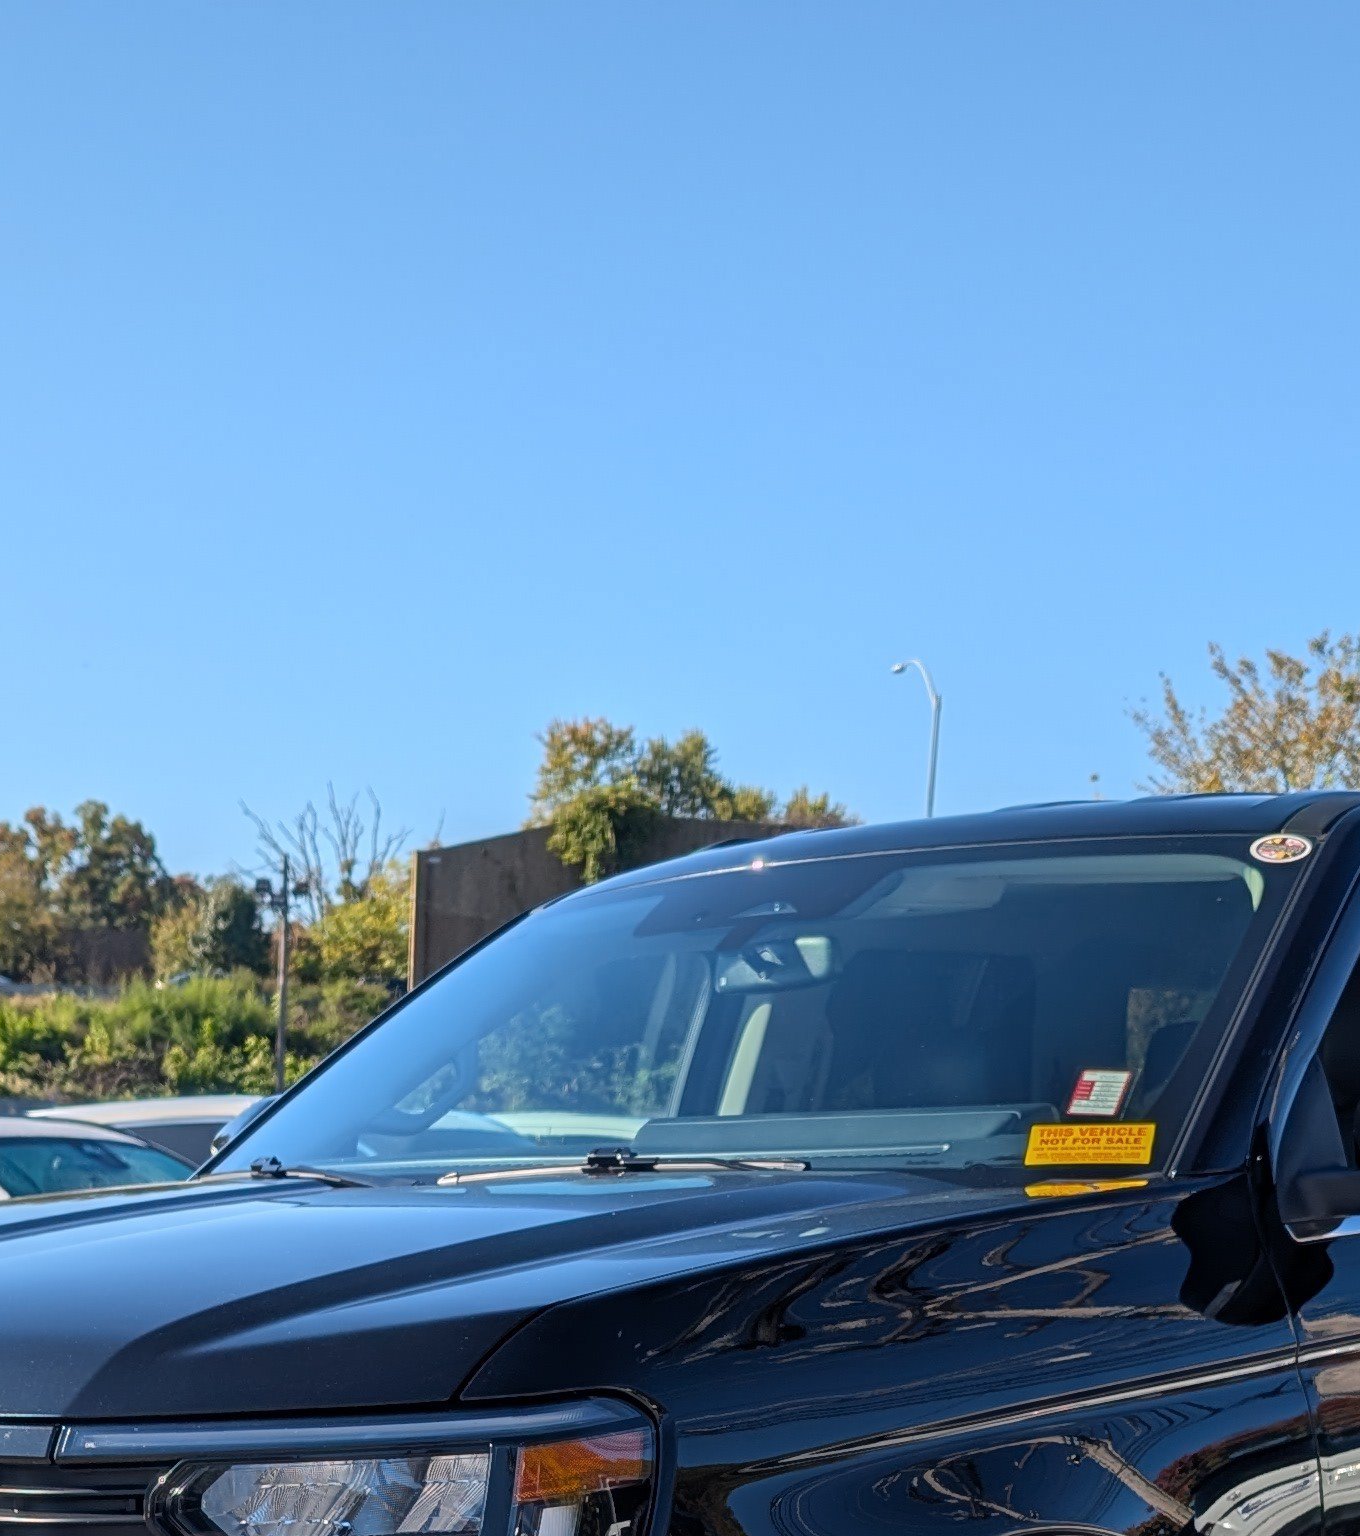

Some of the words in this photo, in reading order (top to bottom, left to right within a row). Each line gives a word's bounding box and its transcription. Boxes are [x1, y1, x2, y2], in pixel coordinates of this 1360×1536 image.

[1039, 1127, 1074, 1138] THIS
[1078, 1126, 1148, 1137] VEHICLE
[1039, 1137, 1068, 1146] NOT
[1071, 1137, 1102, 1145] FOR
[1105, 1137, 1143, 1145] SALE
